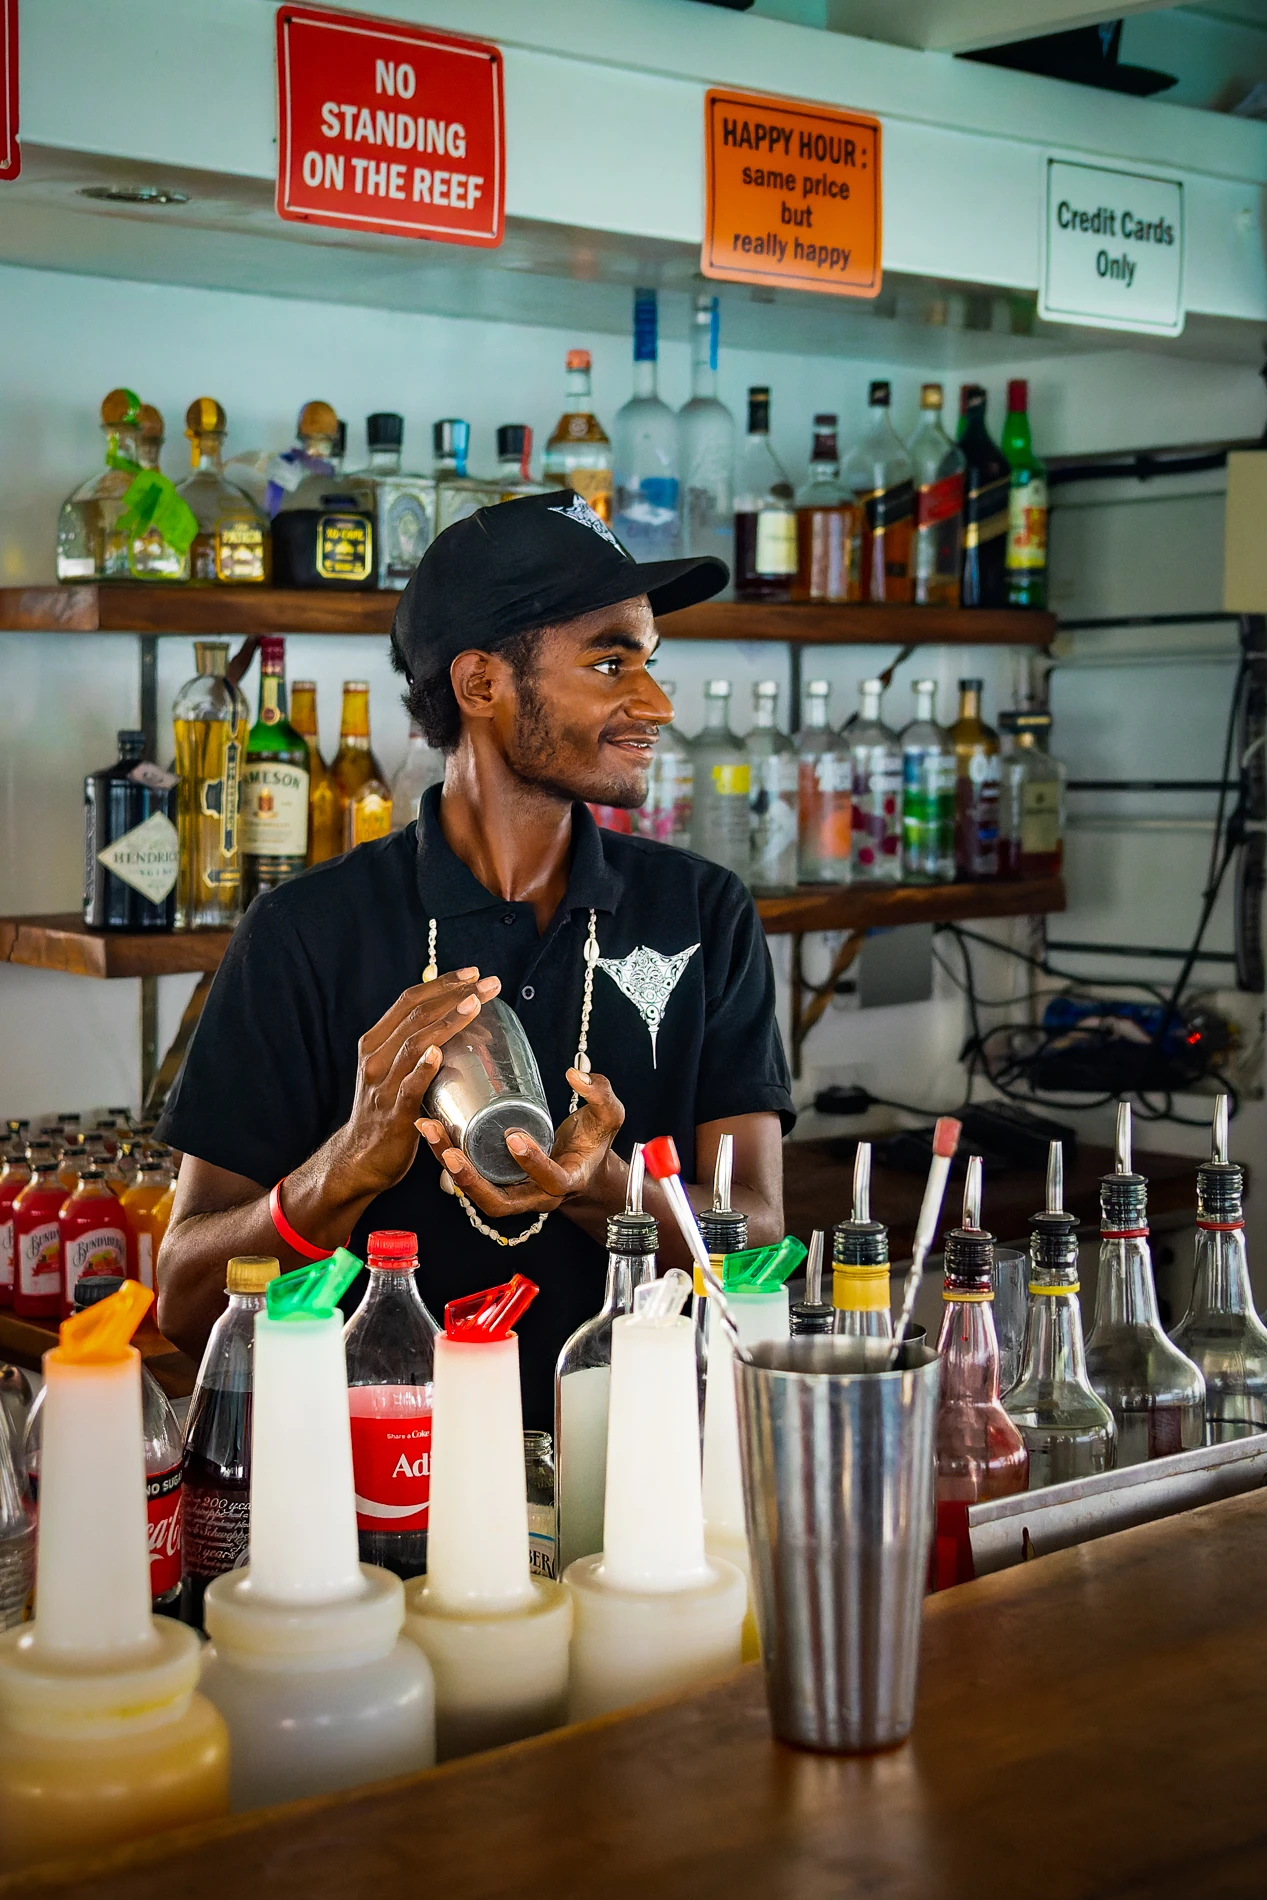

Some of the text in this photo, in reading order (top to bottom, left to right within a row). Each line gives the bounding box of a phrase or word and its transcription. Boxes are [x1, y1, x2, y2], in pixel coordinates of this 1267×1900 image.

[375, 59, 416, 99] NO
[321, 101, 467, 159] STANDING
[723, 117, 794, 156] HAPPY
[303, 151, 484, 210] ON THE REEF
[742, 166, 850, 200] same price
[781, 200, 813, 228] but
[1057, 200, 1174, 246] Credit Cards
[733, 231, 852, 272] really happy
[1096, 249, 1136, 288] Only
[244, 768, 300, 790] AMESON
[411, 1429, 430, 1438] Coke
[391, 1453, 432, 1478] Ad
[203, 1497, 228, 1510] 200
